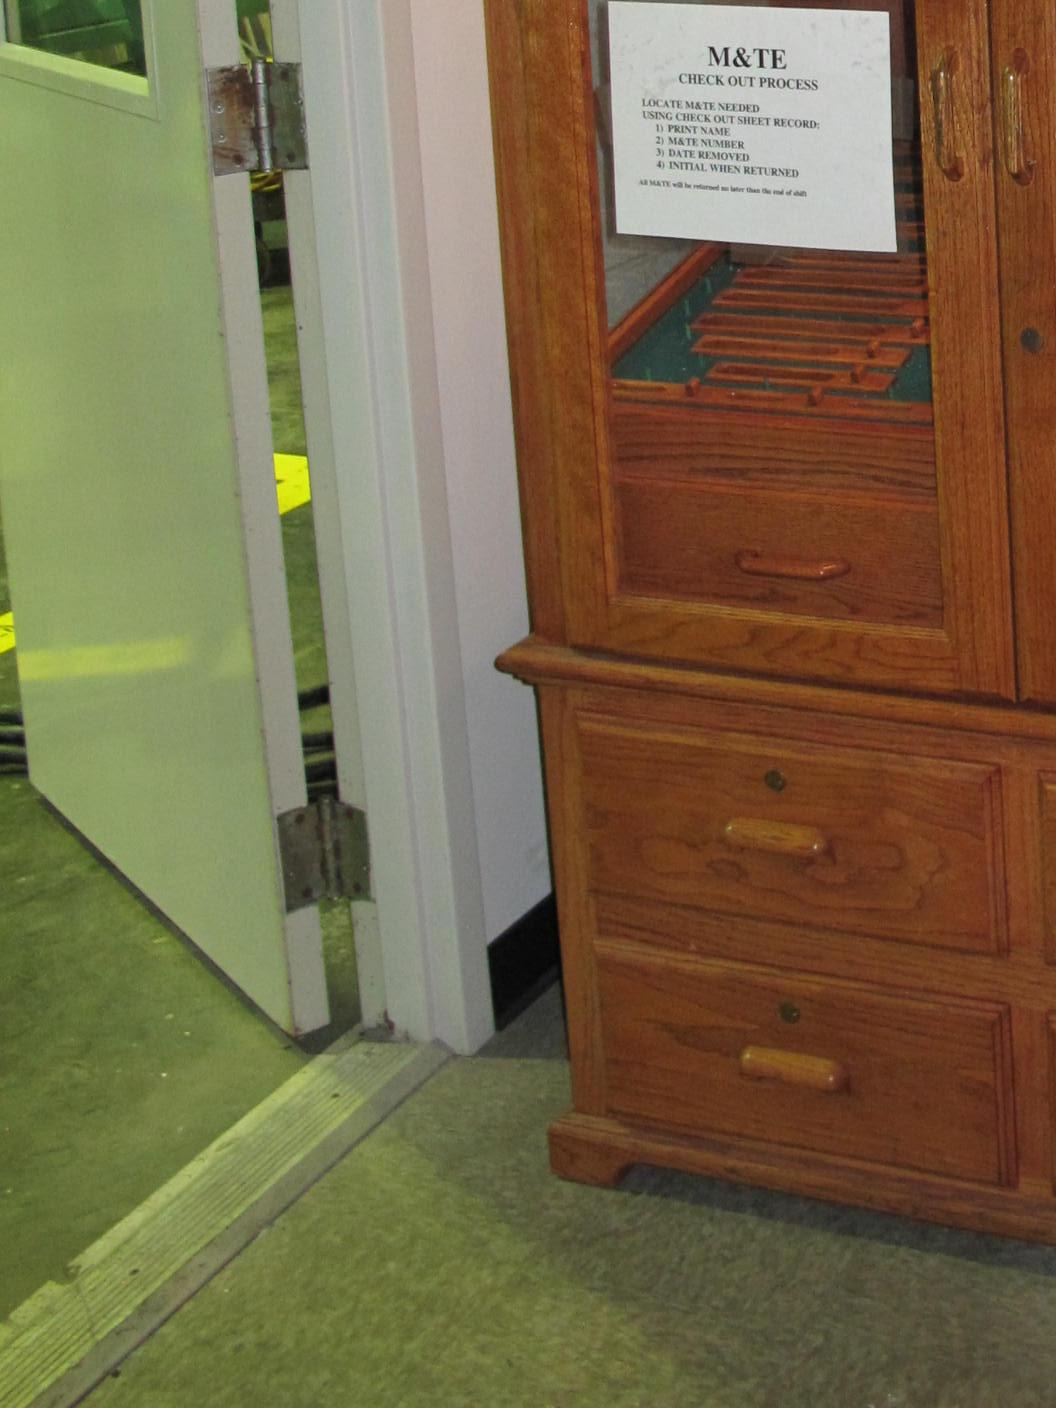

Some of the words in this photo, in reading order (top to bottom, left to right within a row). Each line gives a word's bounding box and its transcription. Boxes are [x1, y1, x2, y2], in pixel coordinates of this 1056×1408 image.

[707, 46, 787, 70] M&TE
[678, 72, 725, 87] CHECK
[727, 75, 757, 88] OUT
[758, 76, 819, 91] PROCESS
[641, 98, 683, 110] LOCATE
[685, 100, 716, 111] M&TE
[717, 102, 761, 114] NEEDED
[642, 110, 673, 122] USING
[674, 112, 712, 123] CHECK
[713, 114, 736, 125] OUT
[737, 115, 771, 127] SHEET
[773, 117, 820, 130] RECORD:
[655, 124, 664, 133] 1)
[667, 124, 699, 135] PRINT
[700, 126, 731, 137] NAME
[655, 136, 665, 146] 2)
[668, 136, 699, 147] M&TE
[700, 138, 745, 150] NUMBER
[655, 148, 665, 158] 3)
[668, 149, 696, 159] DATE
[697, 150, 750, 163] REMOVED
[656, 160, 666, 170] 4)
[668, 161, 708, 173] INITIAL
[709, 163, 741, 175] WHEN
[742, 165, 800, 179] RETURNED
